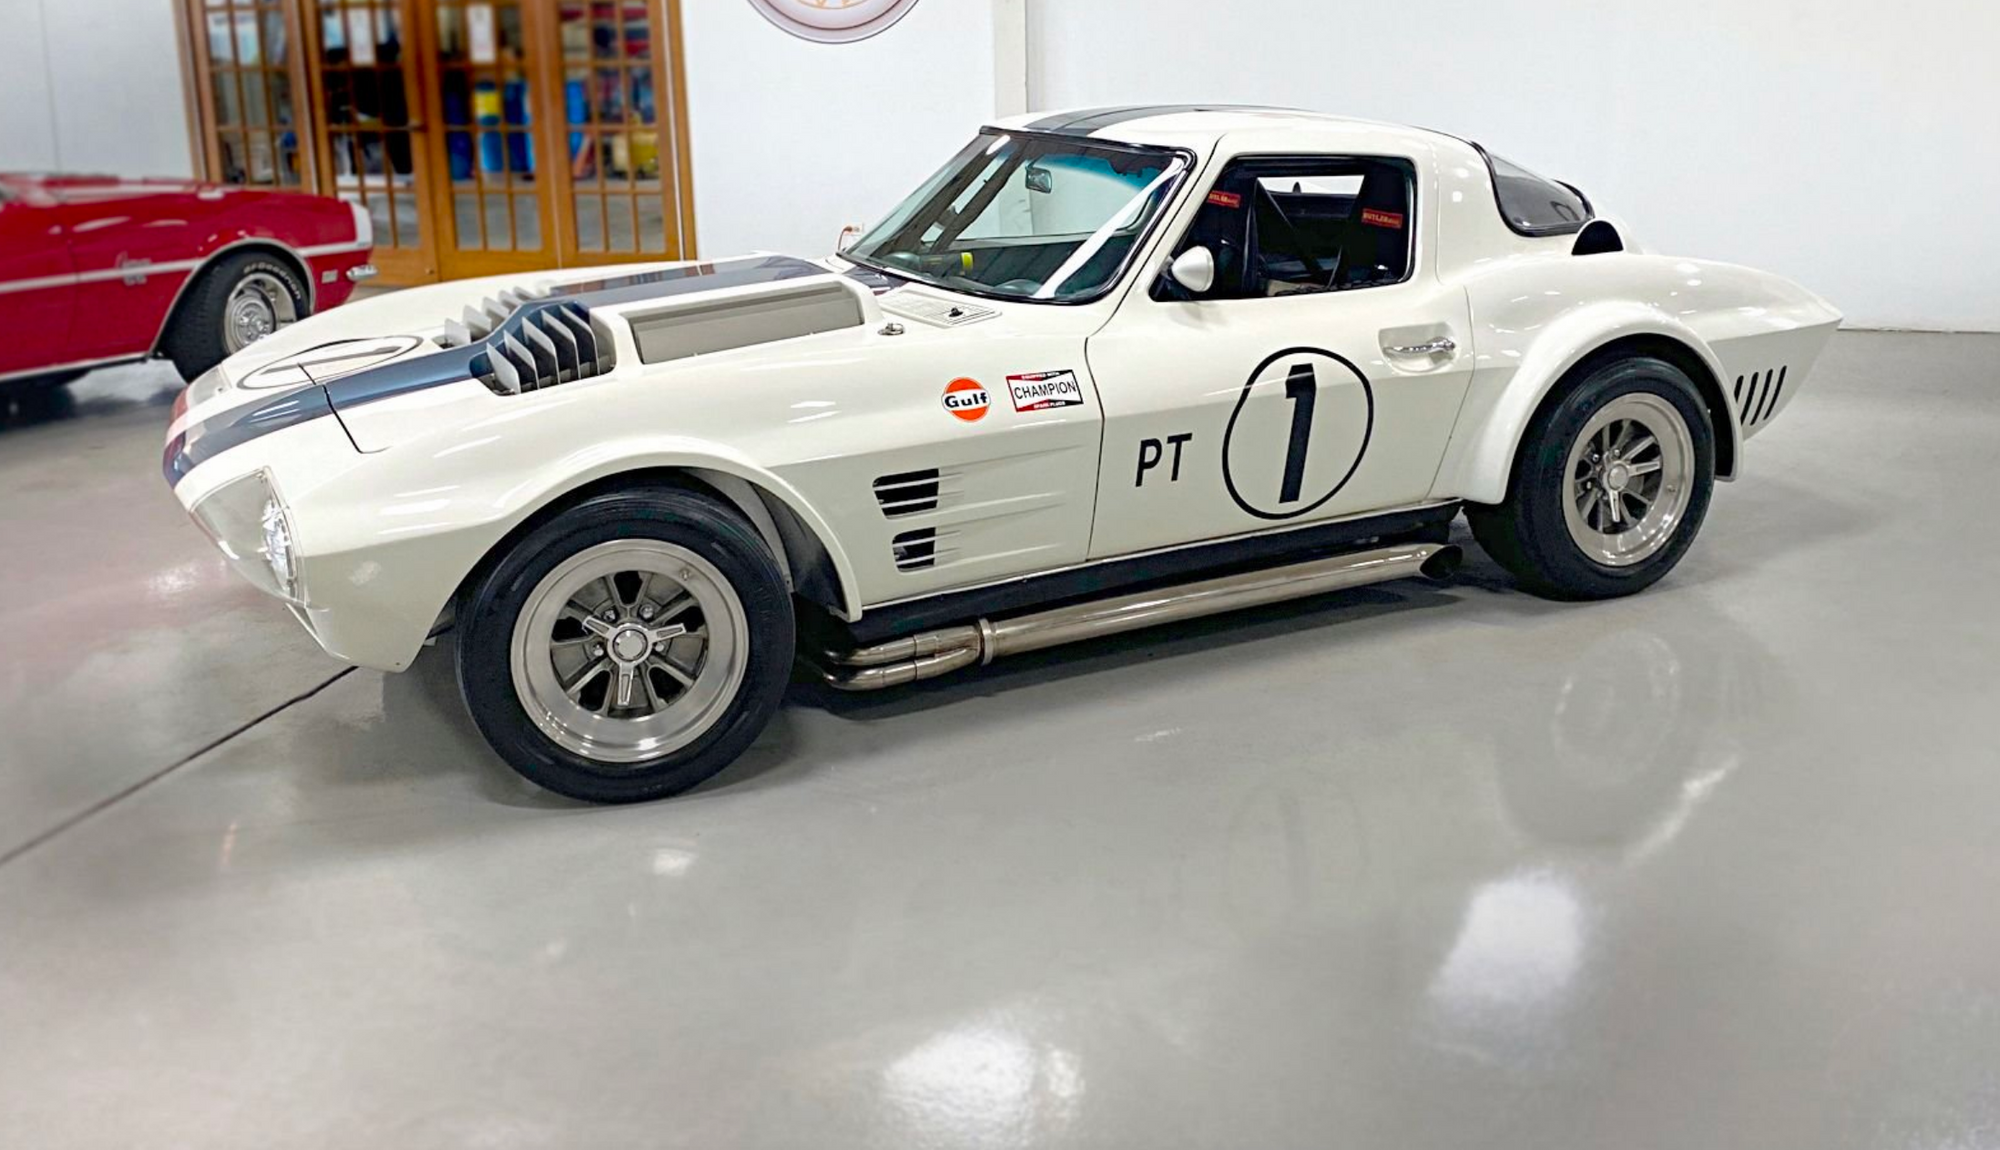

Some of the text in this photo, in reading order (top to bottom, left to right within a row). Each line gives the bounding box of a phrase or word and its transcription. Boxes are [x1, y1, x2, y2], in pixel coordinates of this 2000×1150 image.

[944, 392, 987, 408] Gulf
[1014, 380, 1077, 400] CHAMPION
[1279, 363, 1317, 503] 1
[1135, 432, 1193, 487] PT
